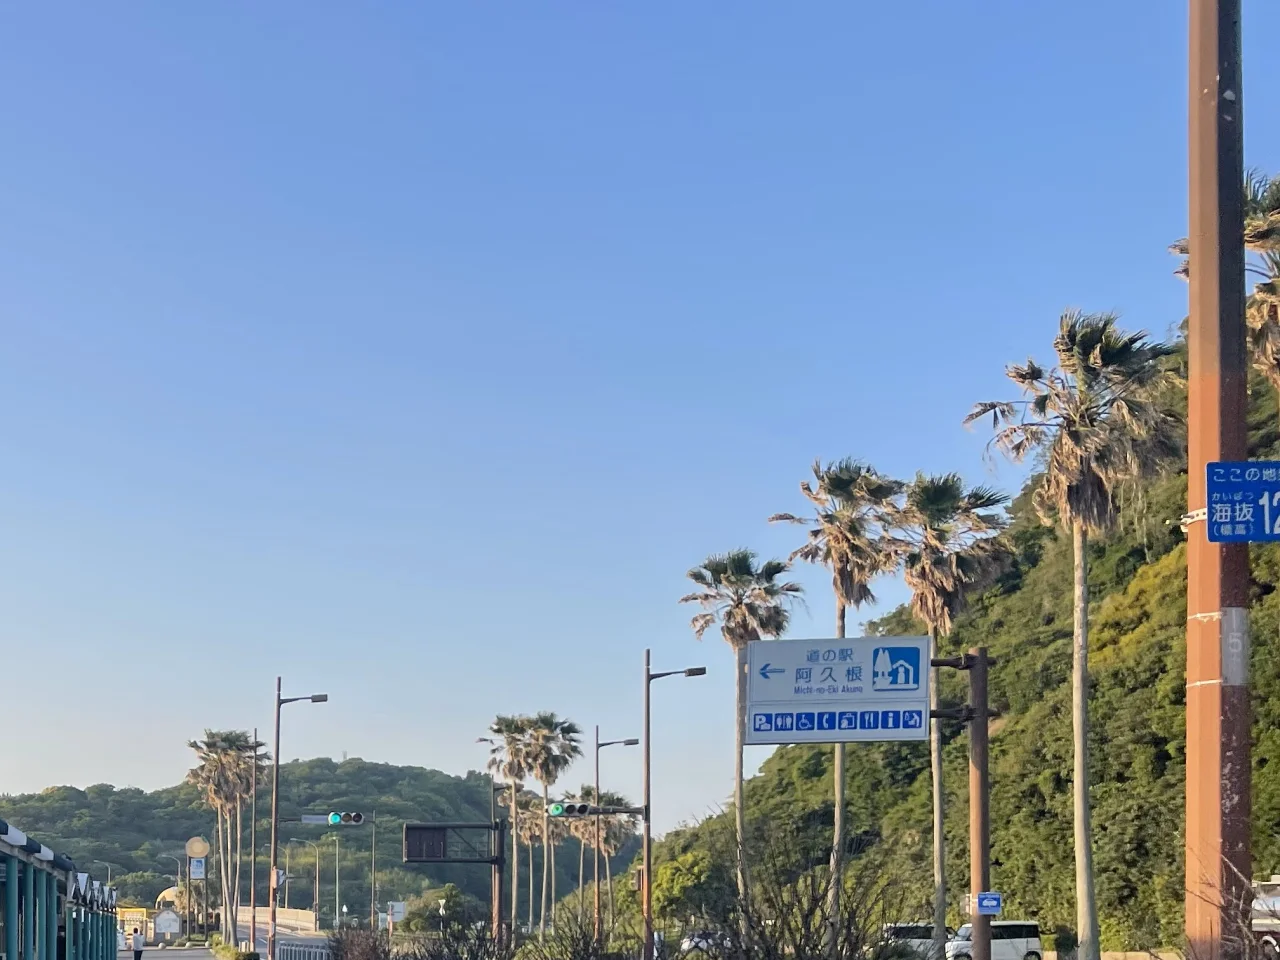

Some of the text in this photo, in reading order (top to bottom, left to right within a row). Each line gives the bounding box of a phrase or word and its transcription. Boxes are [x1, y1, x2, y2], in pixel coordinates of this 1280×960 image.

[1213, 467, 1280, 481] ここの地
[1211, 502, 1254, 522] 海抜
[806, 648, 854, 662] 道の駅
[795, 666, 863, 683] 阿久根
